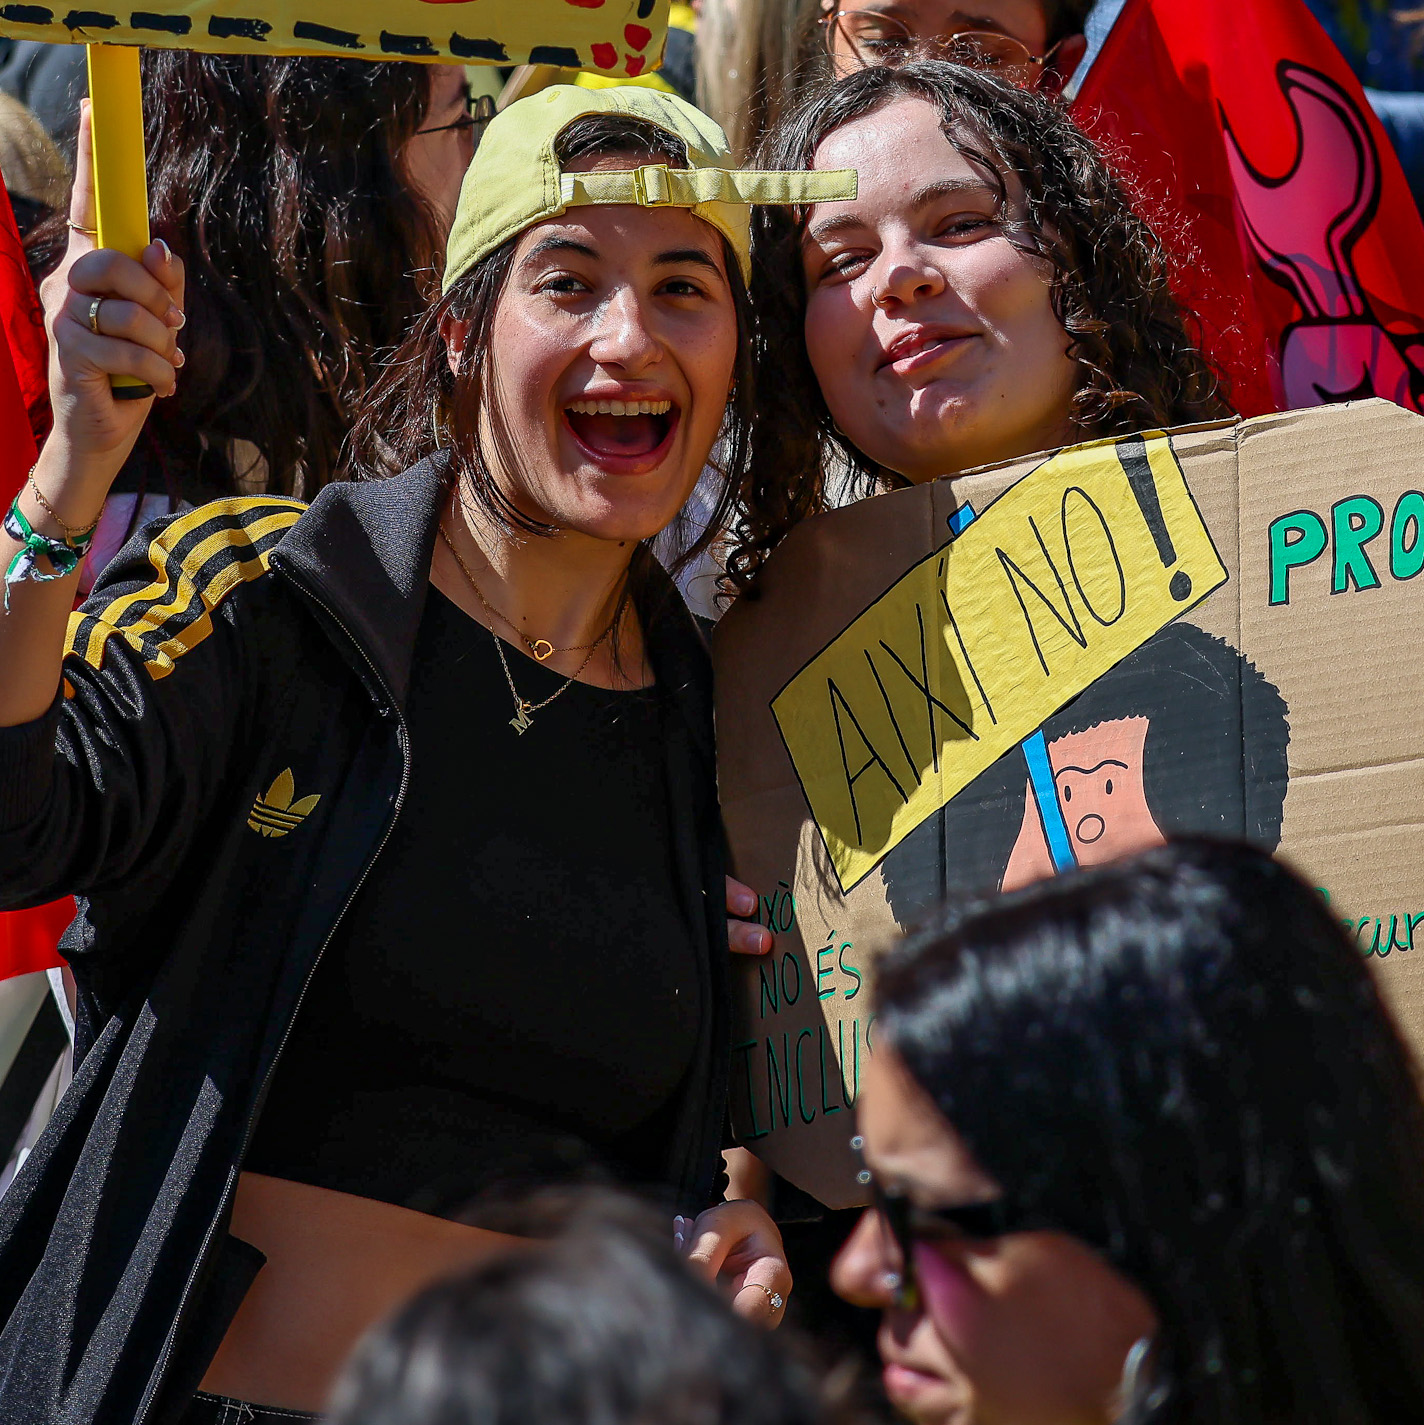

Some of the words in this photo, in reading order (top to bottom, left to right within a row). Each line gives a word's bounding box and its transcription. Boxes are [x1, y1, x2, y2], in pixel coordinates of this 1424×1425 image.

[994, 433, 1193, 677] NO!
[752, 880, 796, 935] IXÒ
[759, 951, 803, 1020] NO
[816, 929, 863, 1001] ÉS
